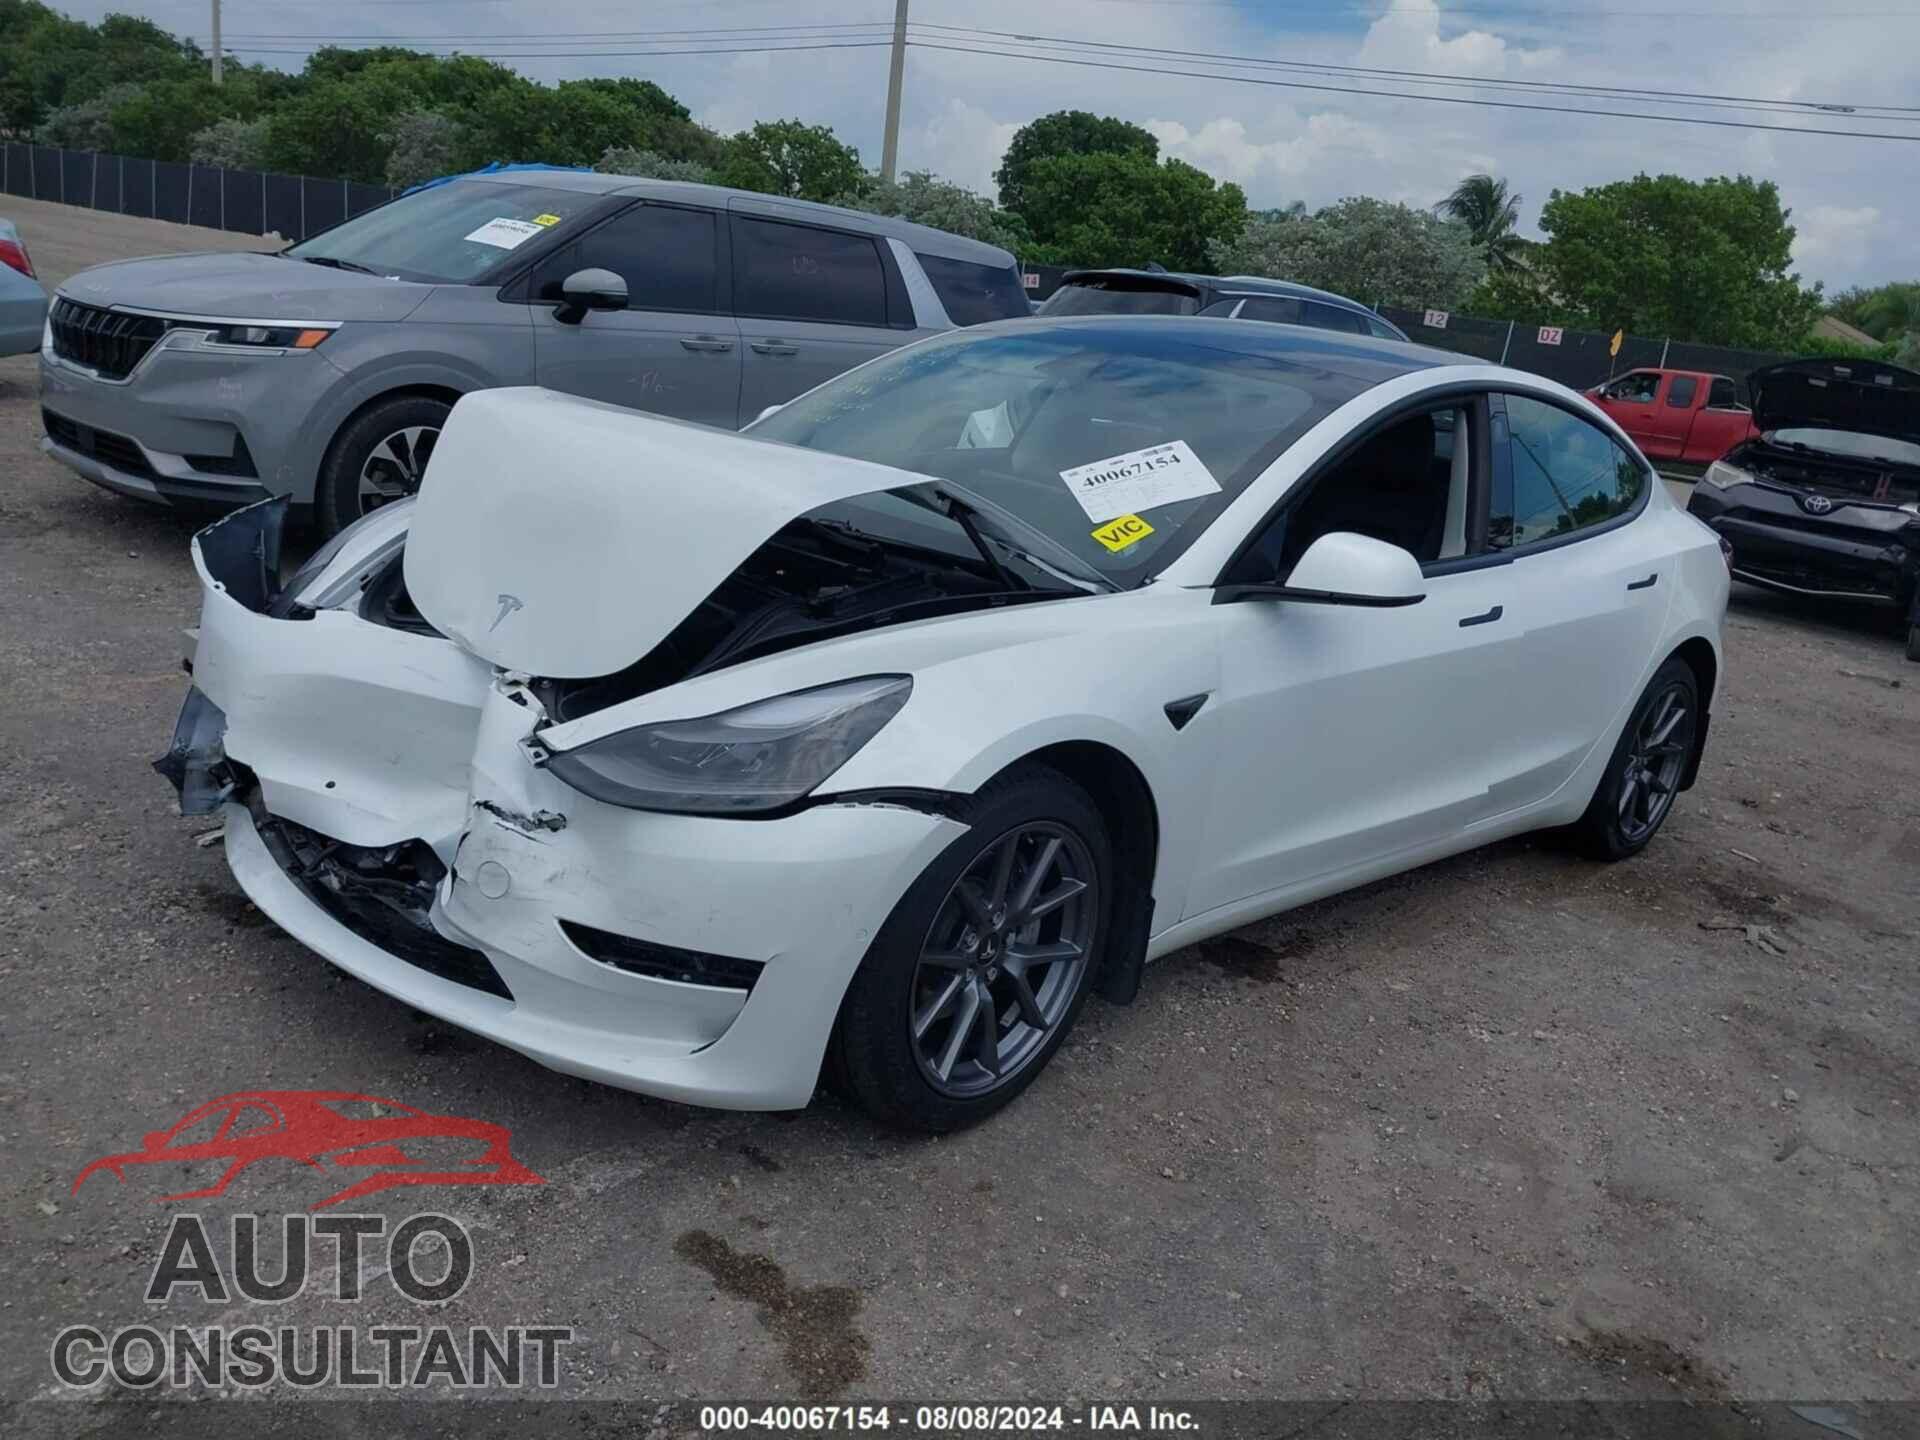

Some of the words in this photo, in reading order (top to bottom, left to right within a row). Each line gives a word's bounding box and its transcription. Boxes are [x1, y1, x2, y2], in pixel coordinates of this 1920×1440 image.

[1430, 312, 1445, 325] 12
[1082, 454, 1181, 488] 40067154
[1101, 519, 1144, 544] VIC
